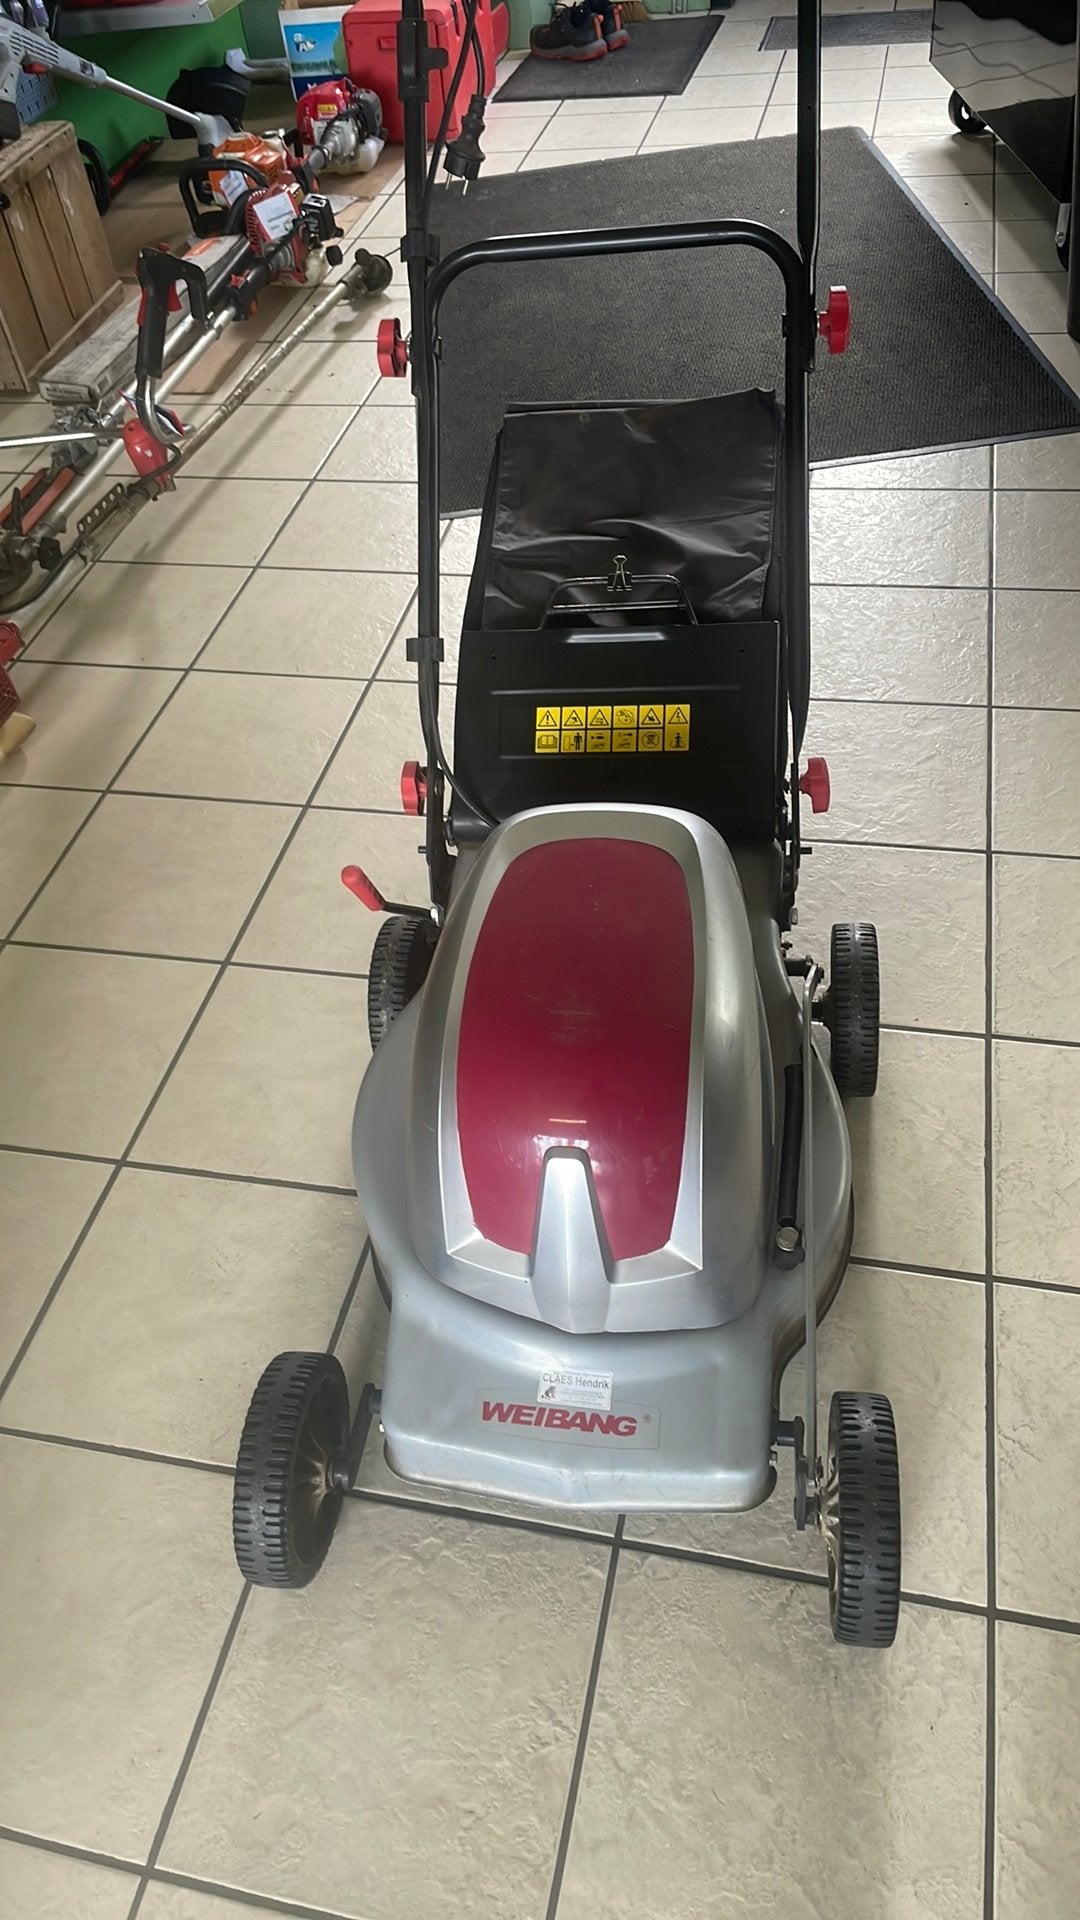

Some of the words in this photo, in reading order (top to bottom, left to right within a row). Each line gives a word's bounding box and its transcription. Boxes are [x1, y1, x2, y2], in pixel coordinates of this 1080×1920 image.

[543, 1373, 573, 1385] CLAES
[575, 1376, 610, 1389] Hendrik
[482, 1401, 638, 1436] WEIBANG
